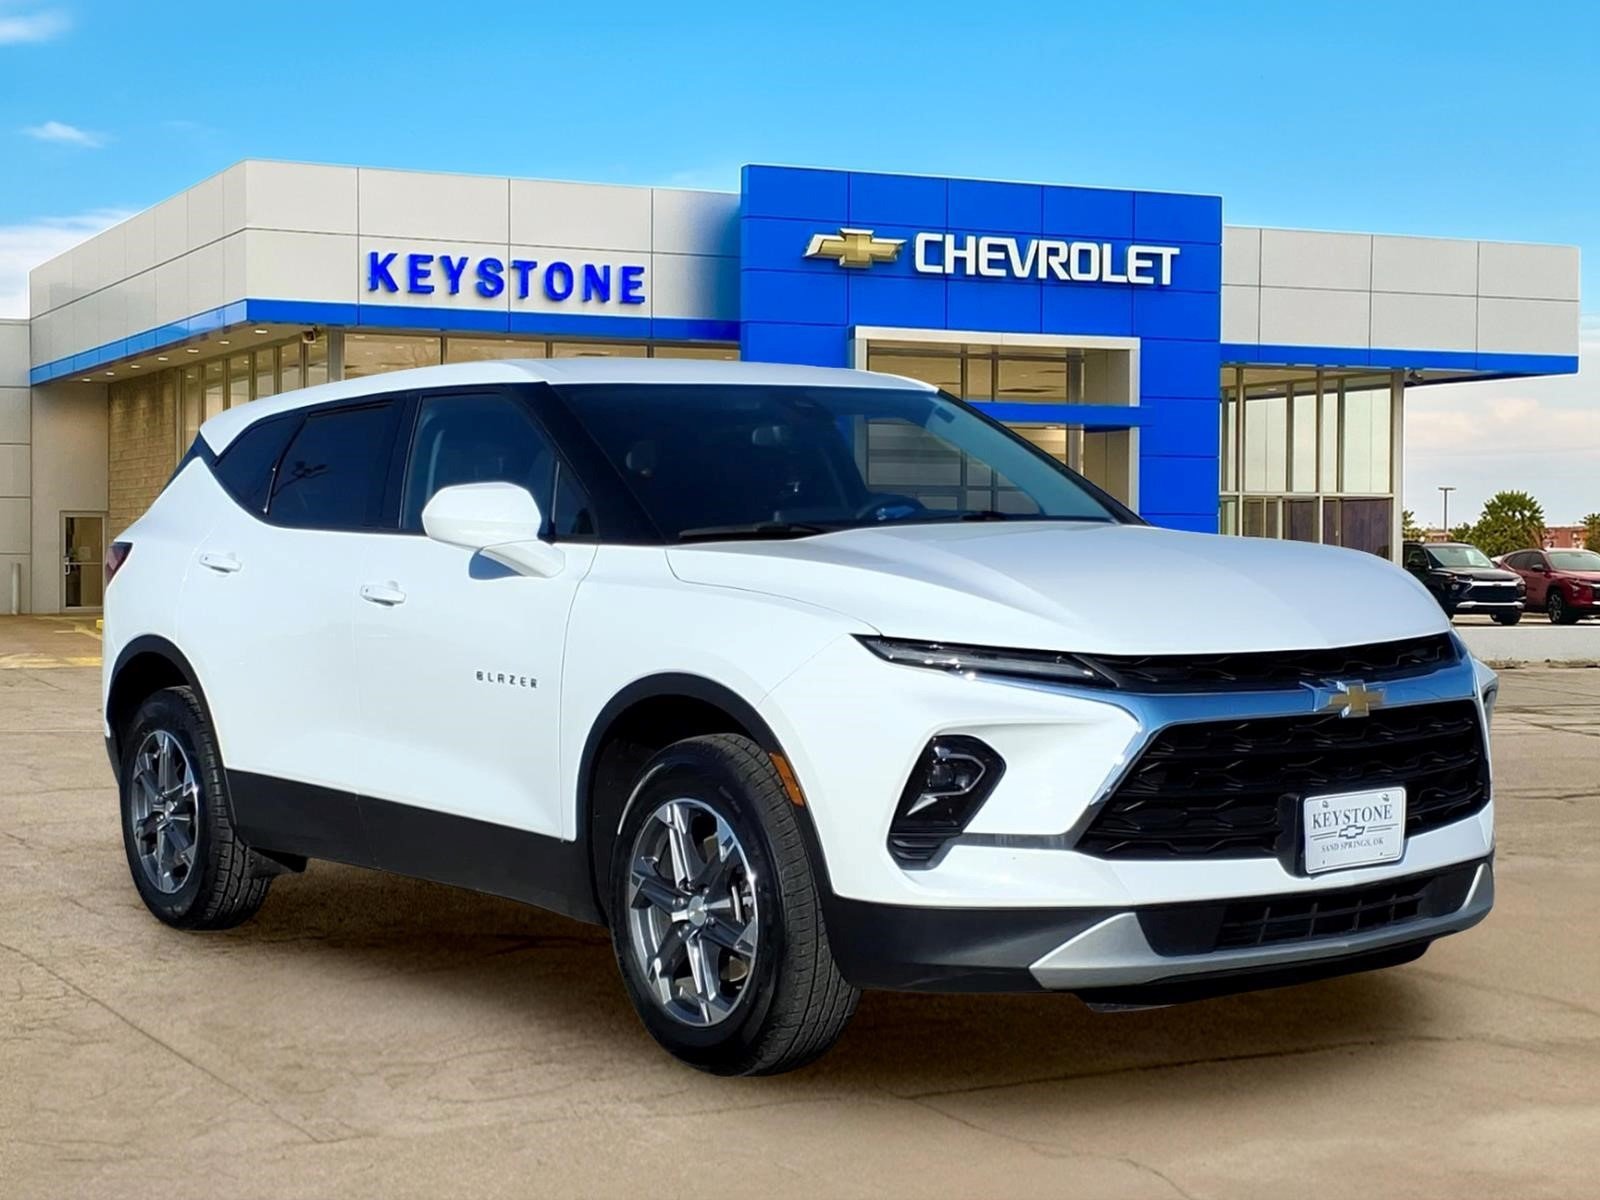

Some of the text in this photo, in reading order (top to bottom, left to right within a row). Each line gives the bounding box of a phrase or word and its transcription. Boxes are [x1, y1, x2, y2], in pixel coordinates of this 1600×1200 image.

[915, 232, 1181, 286] CHEVROLET
[368, 252, 646, 304] KEYSTONE
[476, 671, 537, 688] BLAZER
[1313, 804, 1392, 829] KEYSTONE
[1322, 844, 1339, 853] SAND
[1373, 837, 1384, 845] OK
